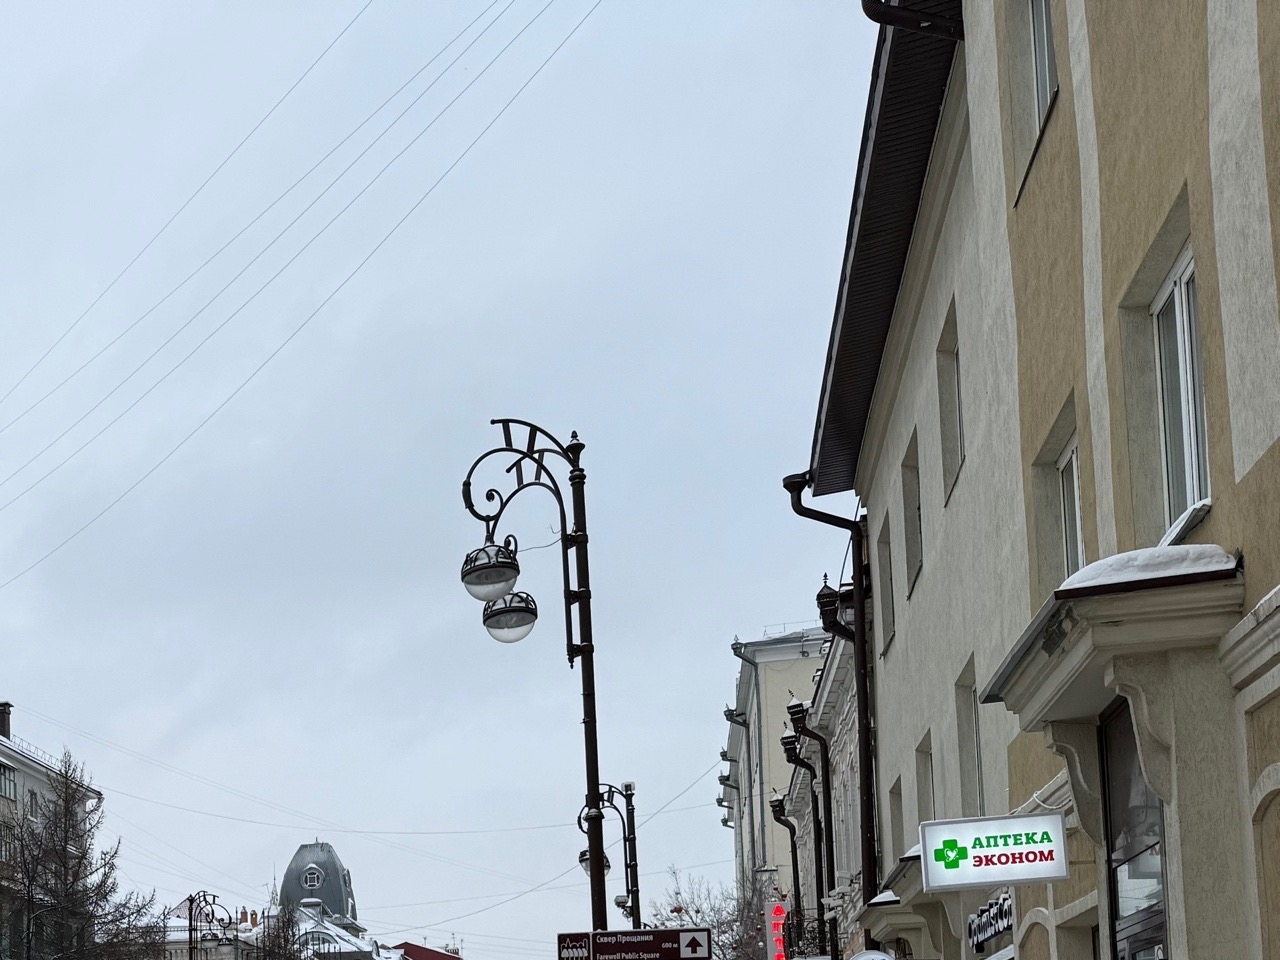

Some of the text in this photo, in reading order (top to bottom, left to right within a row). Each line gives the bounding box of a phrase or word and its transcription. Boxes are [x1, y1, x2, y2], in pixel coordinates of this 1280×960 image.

[971, 831, 1053, 849] АПТЕКА
[972, 850, 1055, 867] ЭКОНОМ
[596, 934, 654, 944] Сквер Прощания
[596, 952, 660, 960] Farewell Public Square
